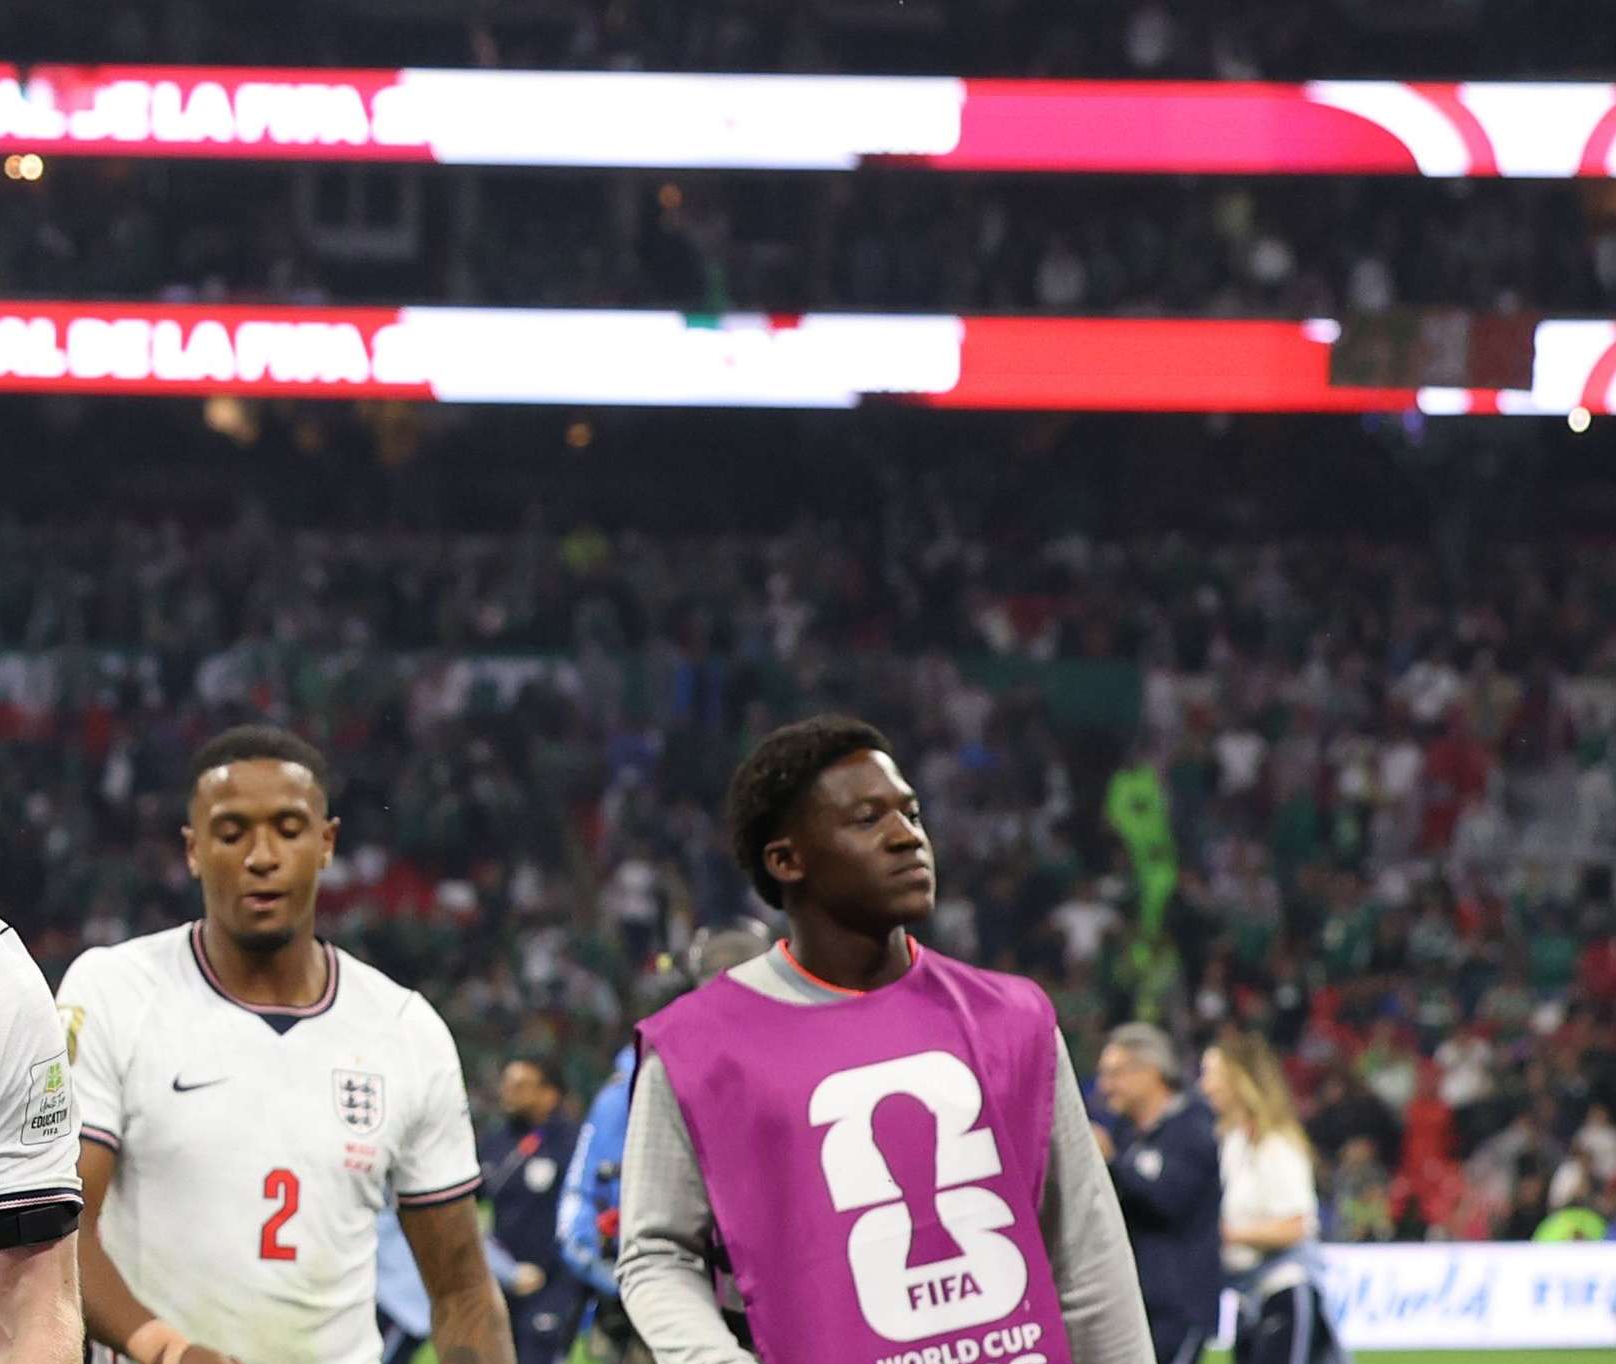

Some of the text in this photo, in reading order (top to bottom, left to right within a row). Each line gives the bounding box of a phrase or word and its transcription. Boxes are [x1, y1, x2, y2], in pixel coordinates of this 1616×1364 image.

[154, 320, 236, 381] LA
[235, 321, 370, 382] FIFA
[259, 1167, 300, 1262] 2
[907, 1272, 983, 1311] FIFA
[982, 1322, 1042, 1358] CUP
